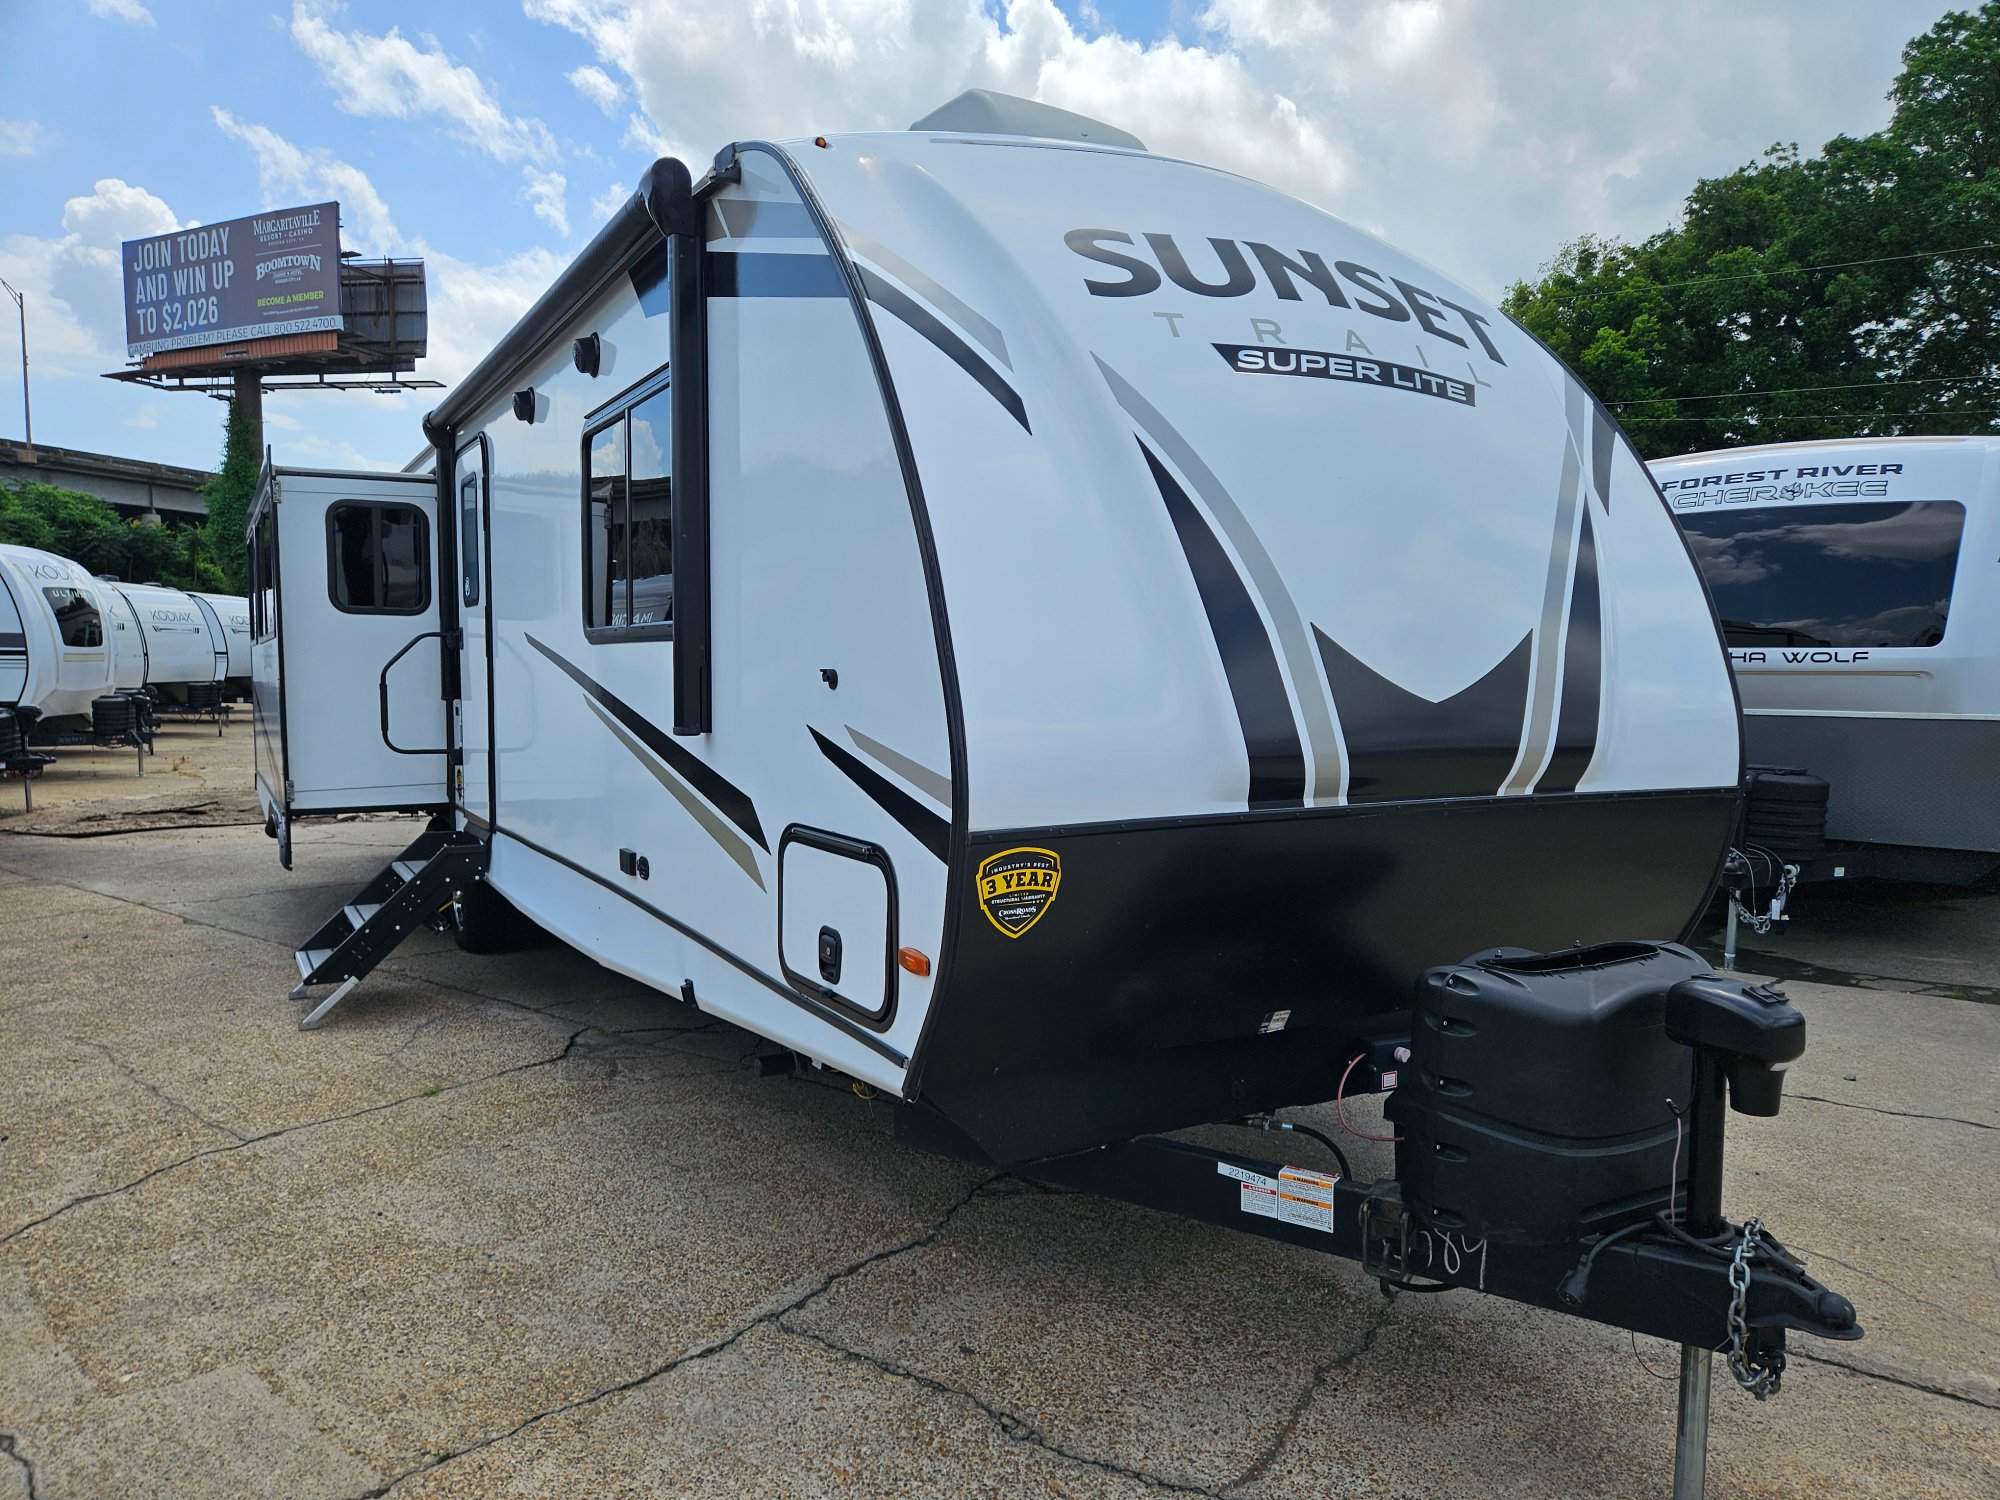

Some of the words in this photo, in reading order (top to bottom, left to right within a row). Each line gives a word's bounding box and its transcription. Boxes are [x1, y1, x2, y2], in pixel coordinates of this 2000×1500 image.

[253, 210, 320, 235] MARGARITAVILLE
[260, 232, 282, 242] RESORT
[288, 228, 313, 237] CASINO
[133, 240, 171, 272] JOIN
[177, 227, 229, 263] TODAY
[255, 254, 321, 281] BOOMTOWN
[136, 273, 168, 304] AND
[173, 265, 206, 297] WIN
[212, 260, 235, 289] UP
[257, 296, 285, 308] BECOME
[286, 295, 292, 304] A
[292, 291, 324, 303] MEMBER
[1064, 228, 1507, 368] SUNSET
[137, 307, 157, 335] TO
[162, 296, 219, 334] $2,026
[128, 342, 169, 354] GAMBLING
[171, 335, 214, 348] PROBLEM?
[217, 328, 248, 341] PLEASE
[250, 324, 272, 336] CALL
[1153, 312, 1491, 388] TRAIL
[1237, 350, 1382, 382] SUPER
[1393, 368, 1467, 400] LITE
[1661, 469, 1789, 492] FOREST
[1796, 464, 1903, 478] RIVER
[150, 609, 194, 622] KODIAK
[1782, 652, 1869, 663] WOLF
[986, 878, 997, 895] 3
[1002, 871, 1054, 890] YEAR
[1228, 1167, 1267, 1186] 2219474
[1296, 1177, 1319, 1186] WARNING
[1296, 1197, 1319, 1206] WARNING
